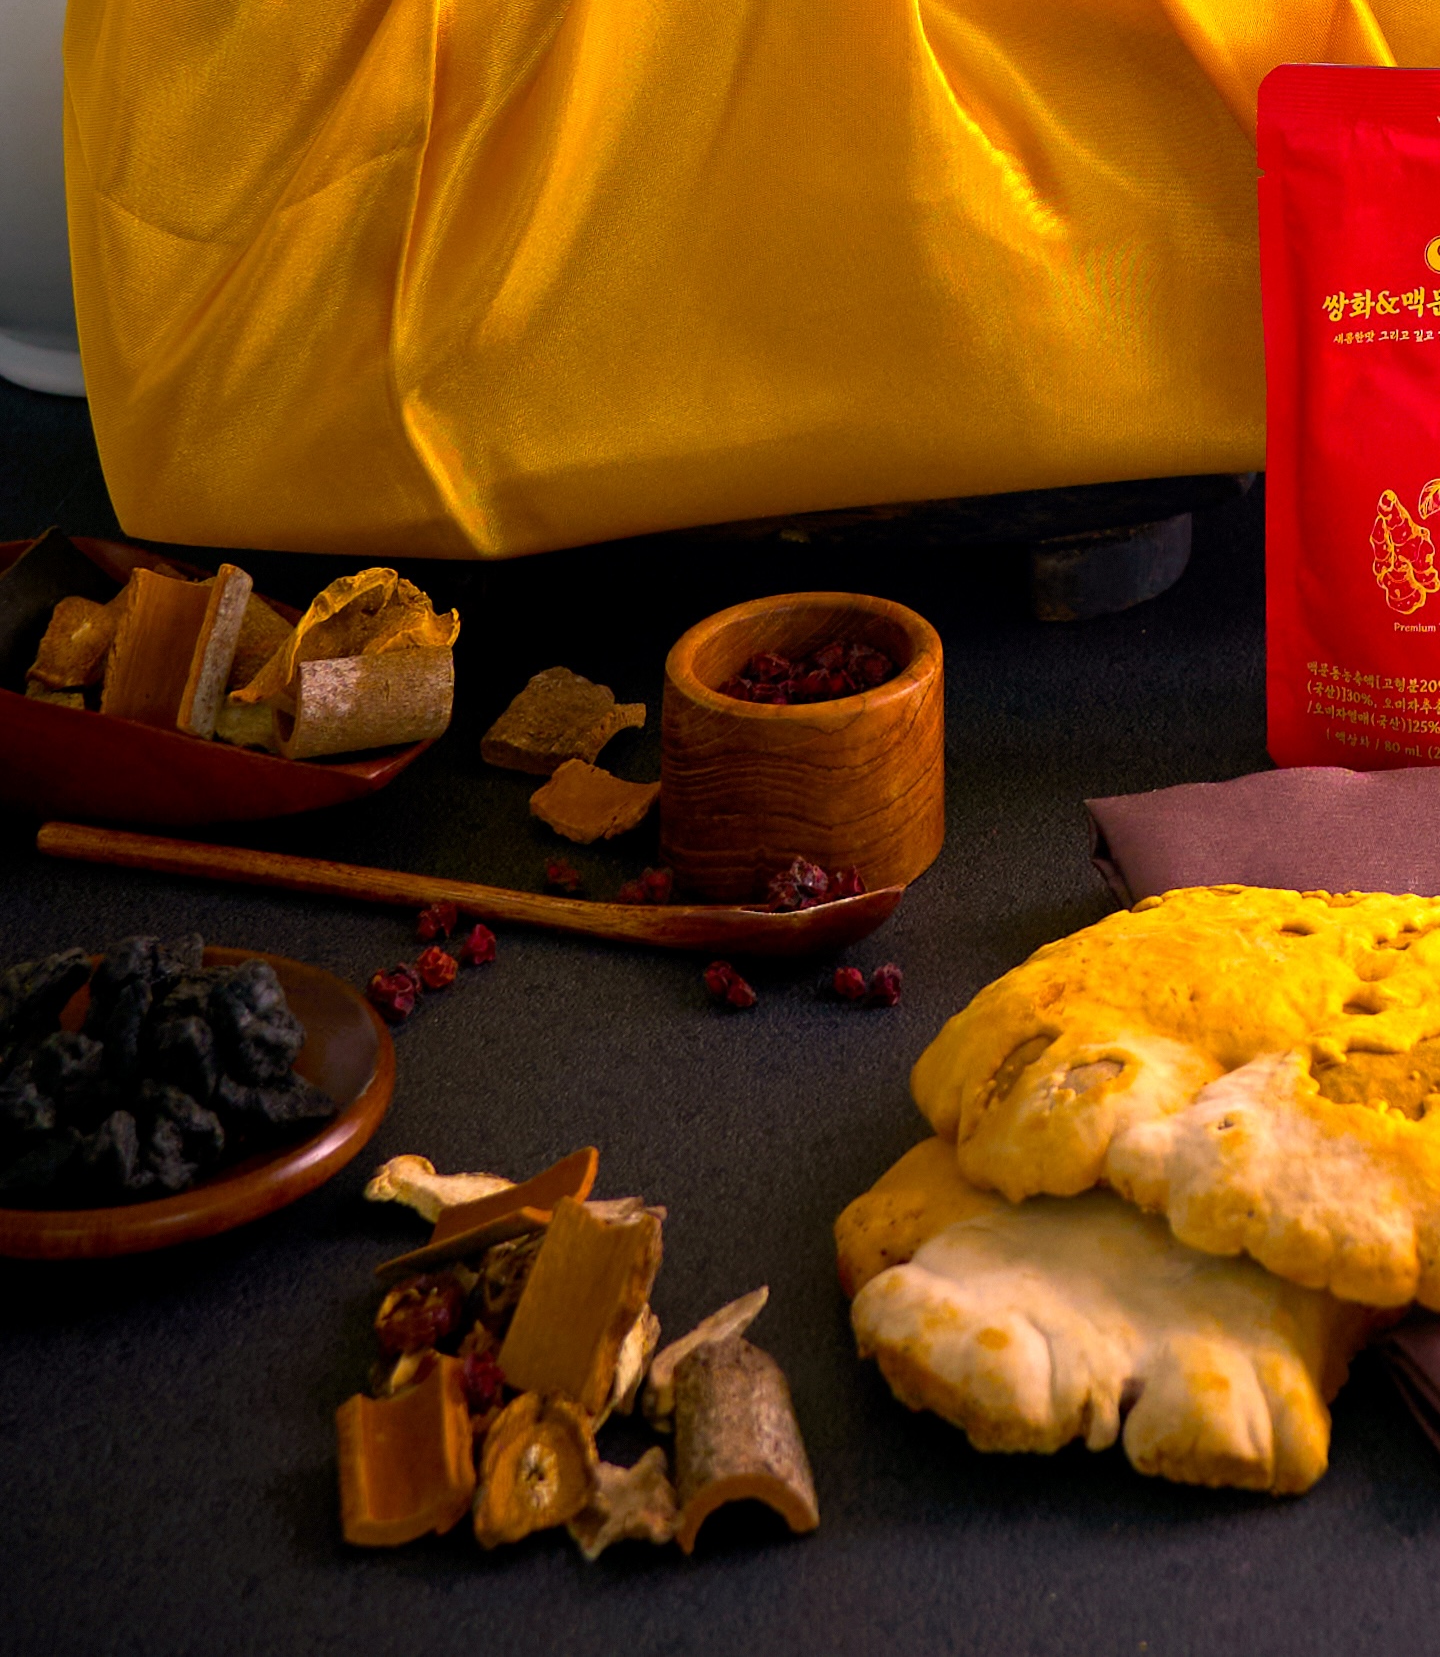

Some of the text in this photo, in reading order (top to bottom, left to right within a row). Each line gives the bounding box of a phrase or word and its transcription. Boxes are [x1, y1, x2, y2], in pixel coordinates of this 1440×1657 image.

[1378, 329, 1410, 342] 그리고
[1413, 329, 1435, 341] 깊고
[1394, 622, 1436, 633] Premium
[1384, 740, 1401, 753] 80
